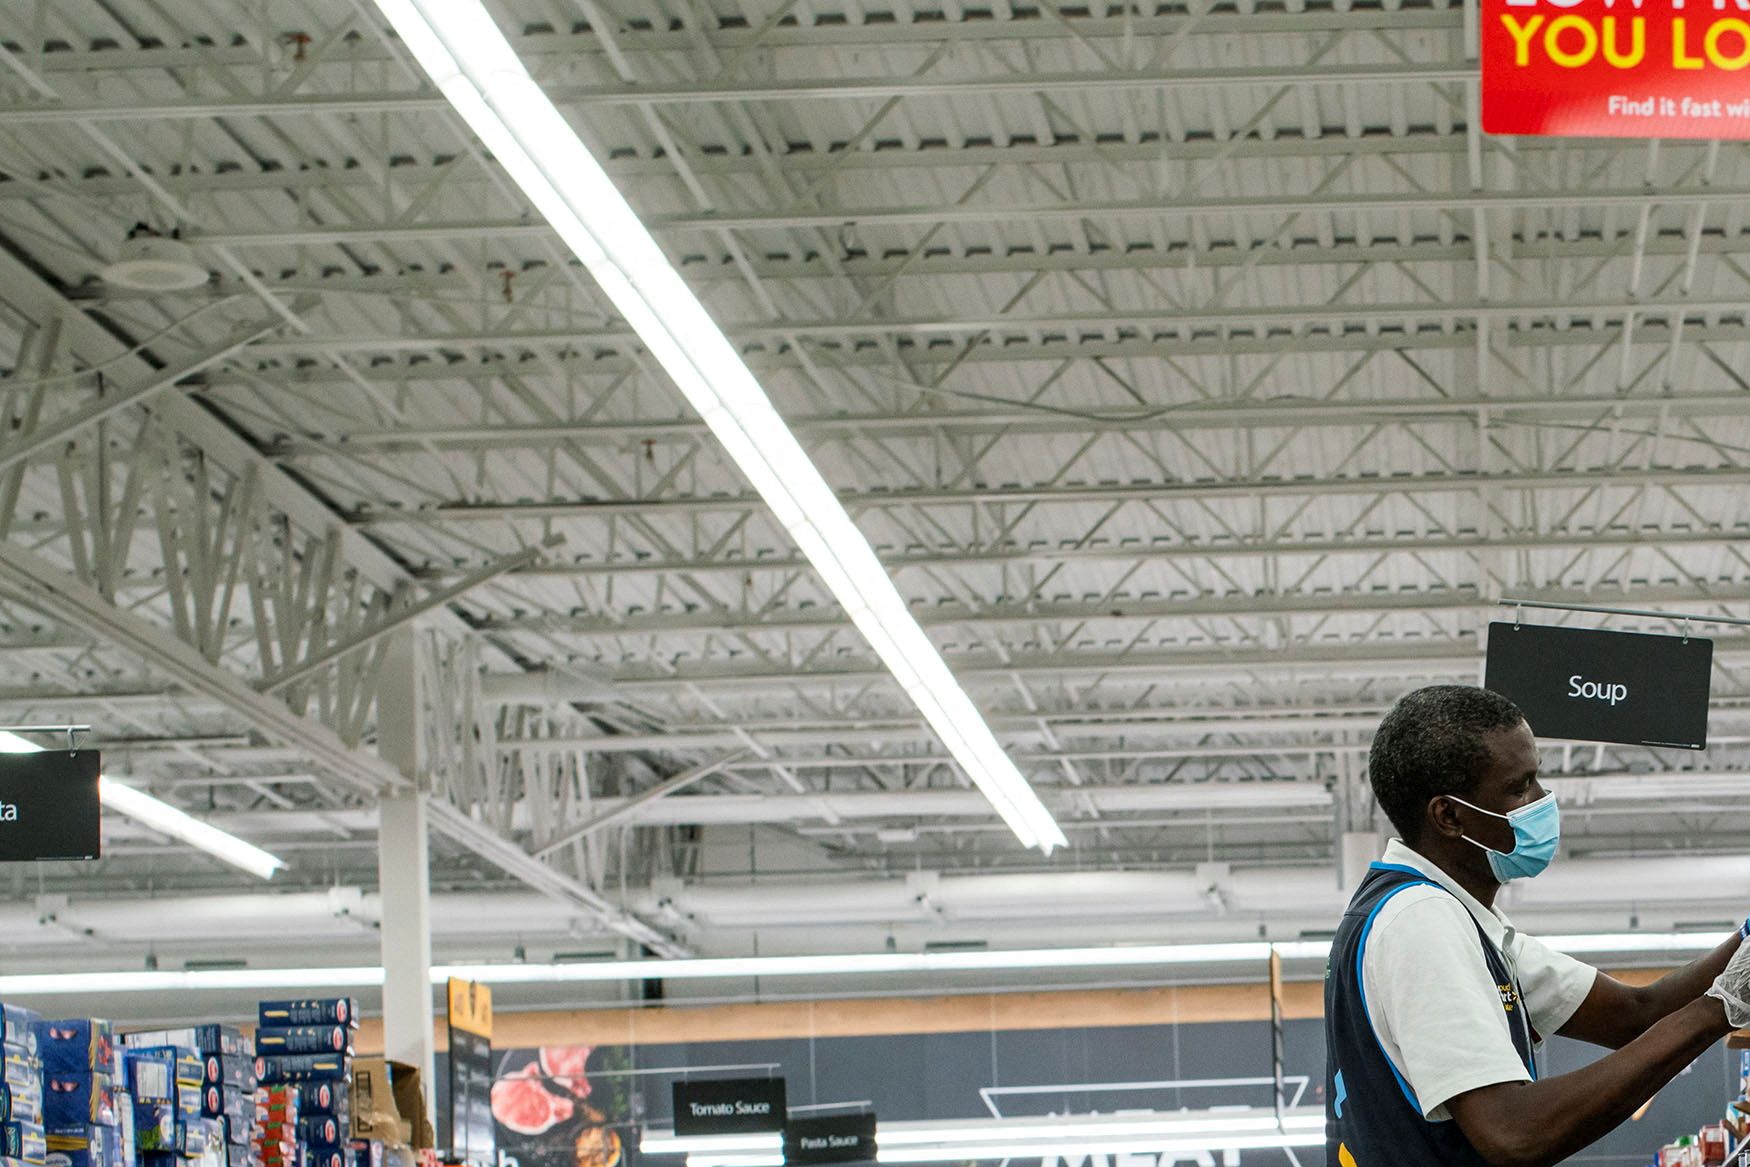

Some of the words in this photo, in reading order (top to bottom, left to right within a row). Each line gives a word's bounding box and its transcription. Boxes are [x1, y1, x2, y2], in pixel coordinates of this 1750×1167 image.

[1501, 15, 1646, 68] YOU
[1608, 97, 1655, 117] Find
[1659, 98, 1676, 117] it
[1680, 99, 1721, 119] fast
[1568, 675, 1627, 706] Soup
[690, 1103, 732, 1116] Tomato
[735, 1101, 770, 1115] Sauce
[801, 1137, 827, 1149] Pasta
[829, 1135, 858, 1147] Sauce
